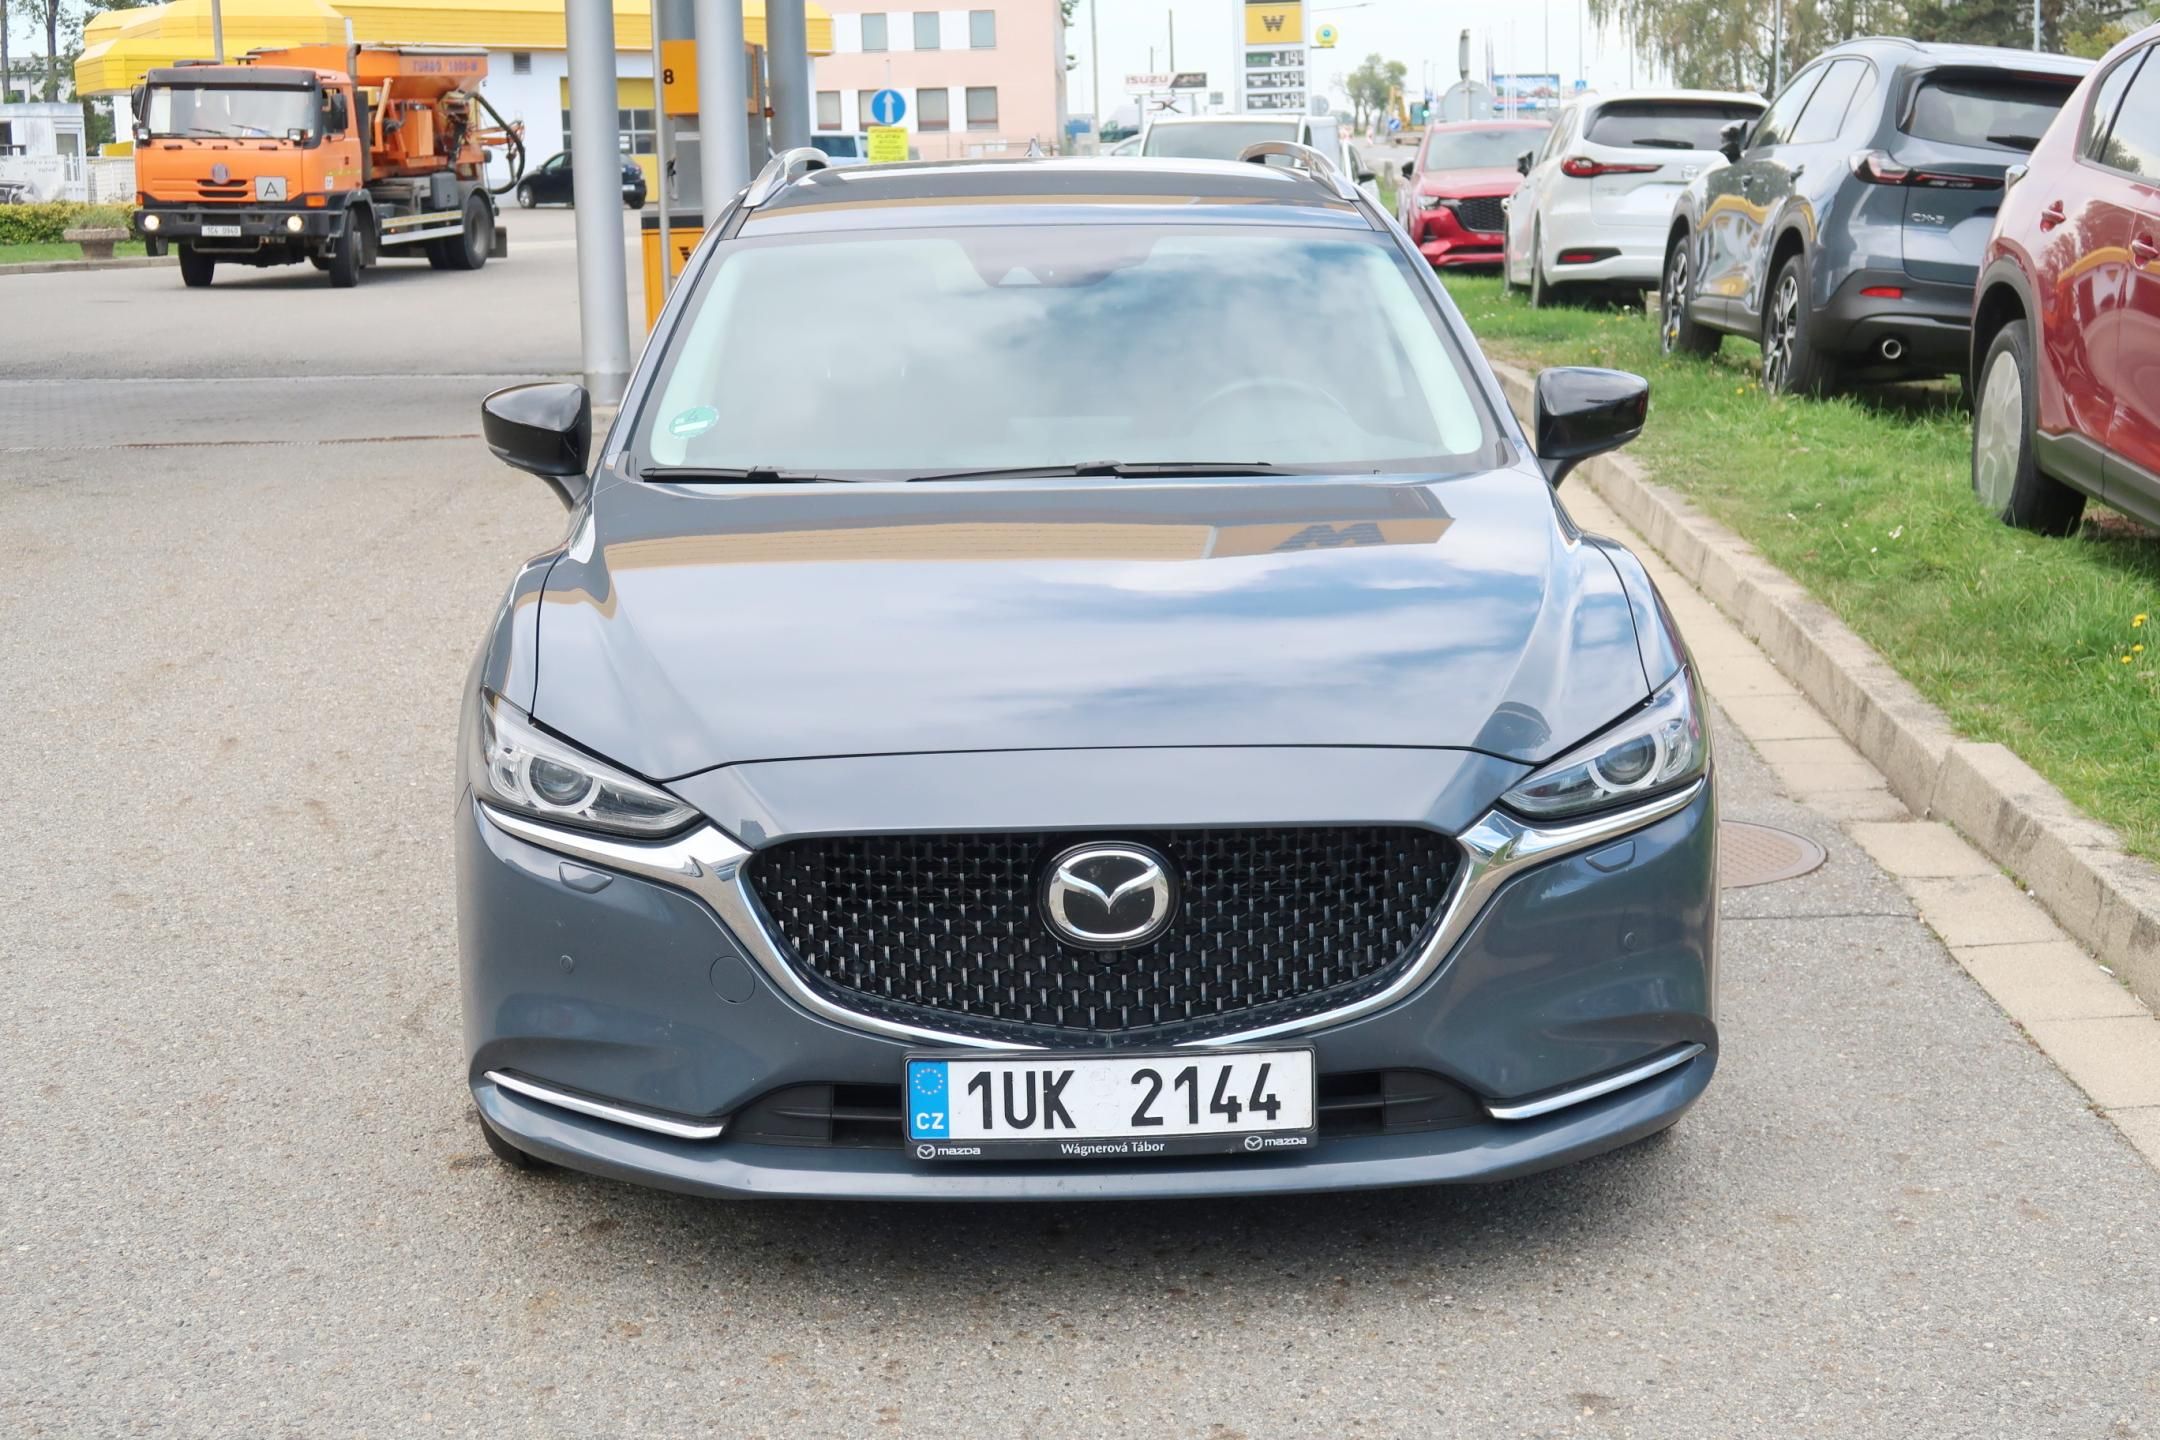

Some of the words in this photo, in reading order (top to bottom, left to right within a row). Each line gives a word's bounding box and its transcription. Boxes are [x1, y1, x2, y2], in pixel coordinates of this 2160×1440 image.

[1262, 15, 1285, 32] W
[663, 68, 675, 85] 8
[1126, 75, 1168, 85] ISUZU
[264, 182, 279, 197] A
[968, 1070, 1077, 1130] 1UK
[1130, 1063, 1282, 1127] 2144
[916, 1112, 944, 1130] CZ
[1060, 1141, 1128, 1156] Wágnerová
[1130, 1140, 1165, 1153] Tábor
[1264, 1136, 1307, 1147] mazda
[937, 1146, 981, 1156] mazda
